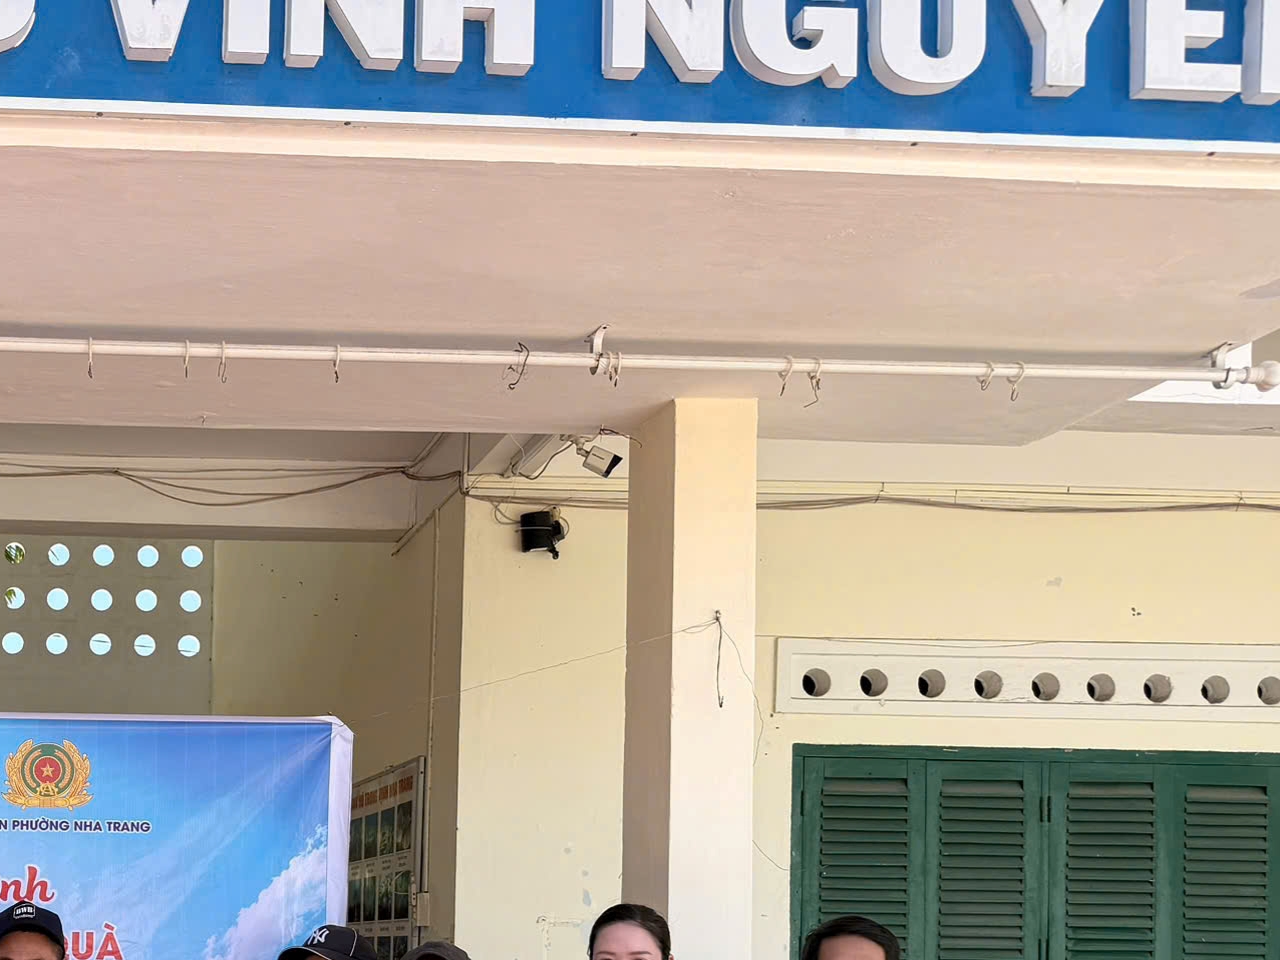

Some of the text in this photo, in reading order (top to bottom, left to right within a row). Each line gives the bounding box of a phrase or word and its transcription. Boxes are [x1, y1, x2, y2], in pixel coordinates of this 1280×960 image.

[12, 816, 70, 831] PHƯỜNG
[73, 820, 102, 832] NHA
[106, 821, 151, 833] TRANG
[64, 922, 123, 960] UÀ
